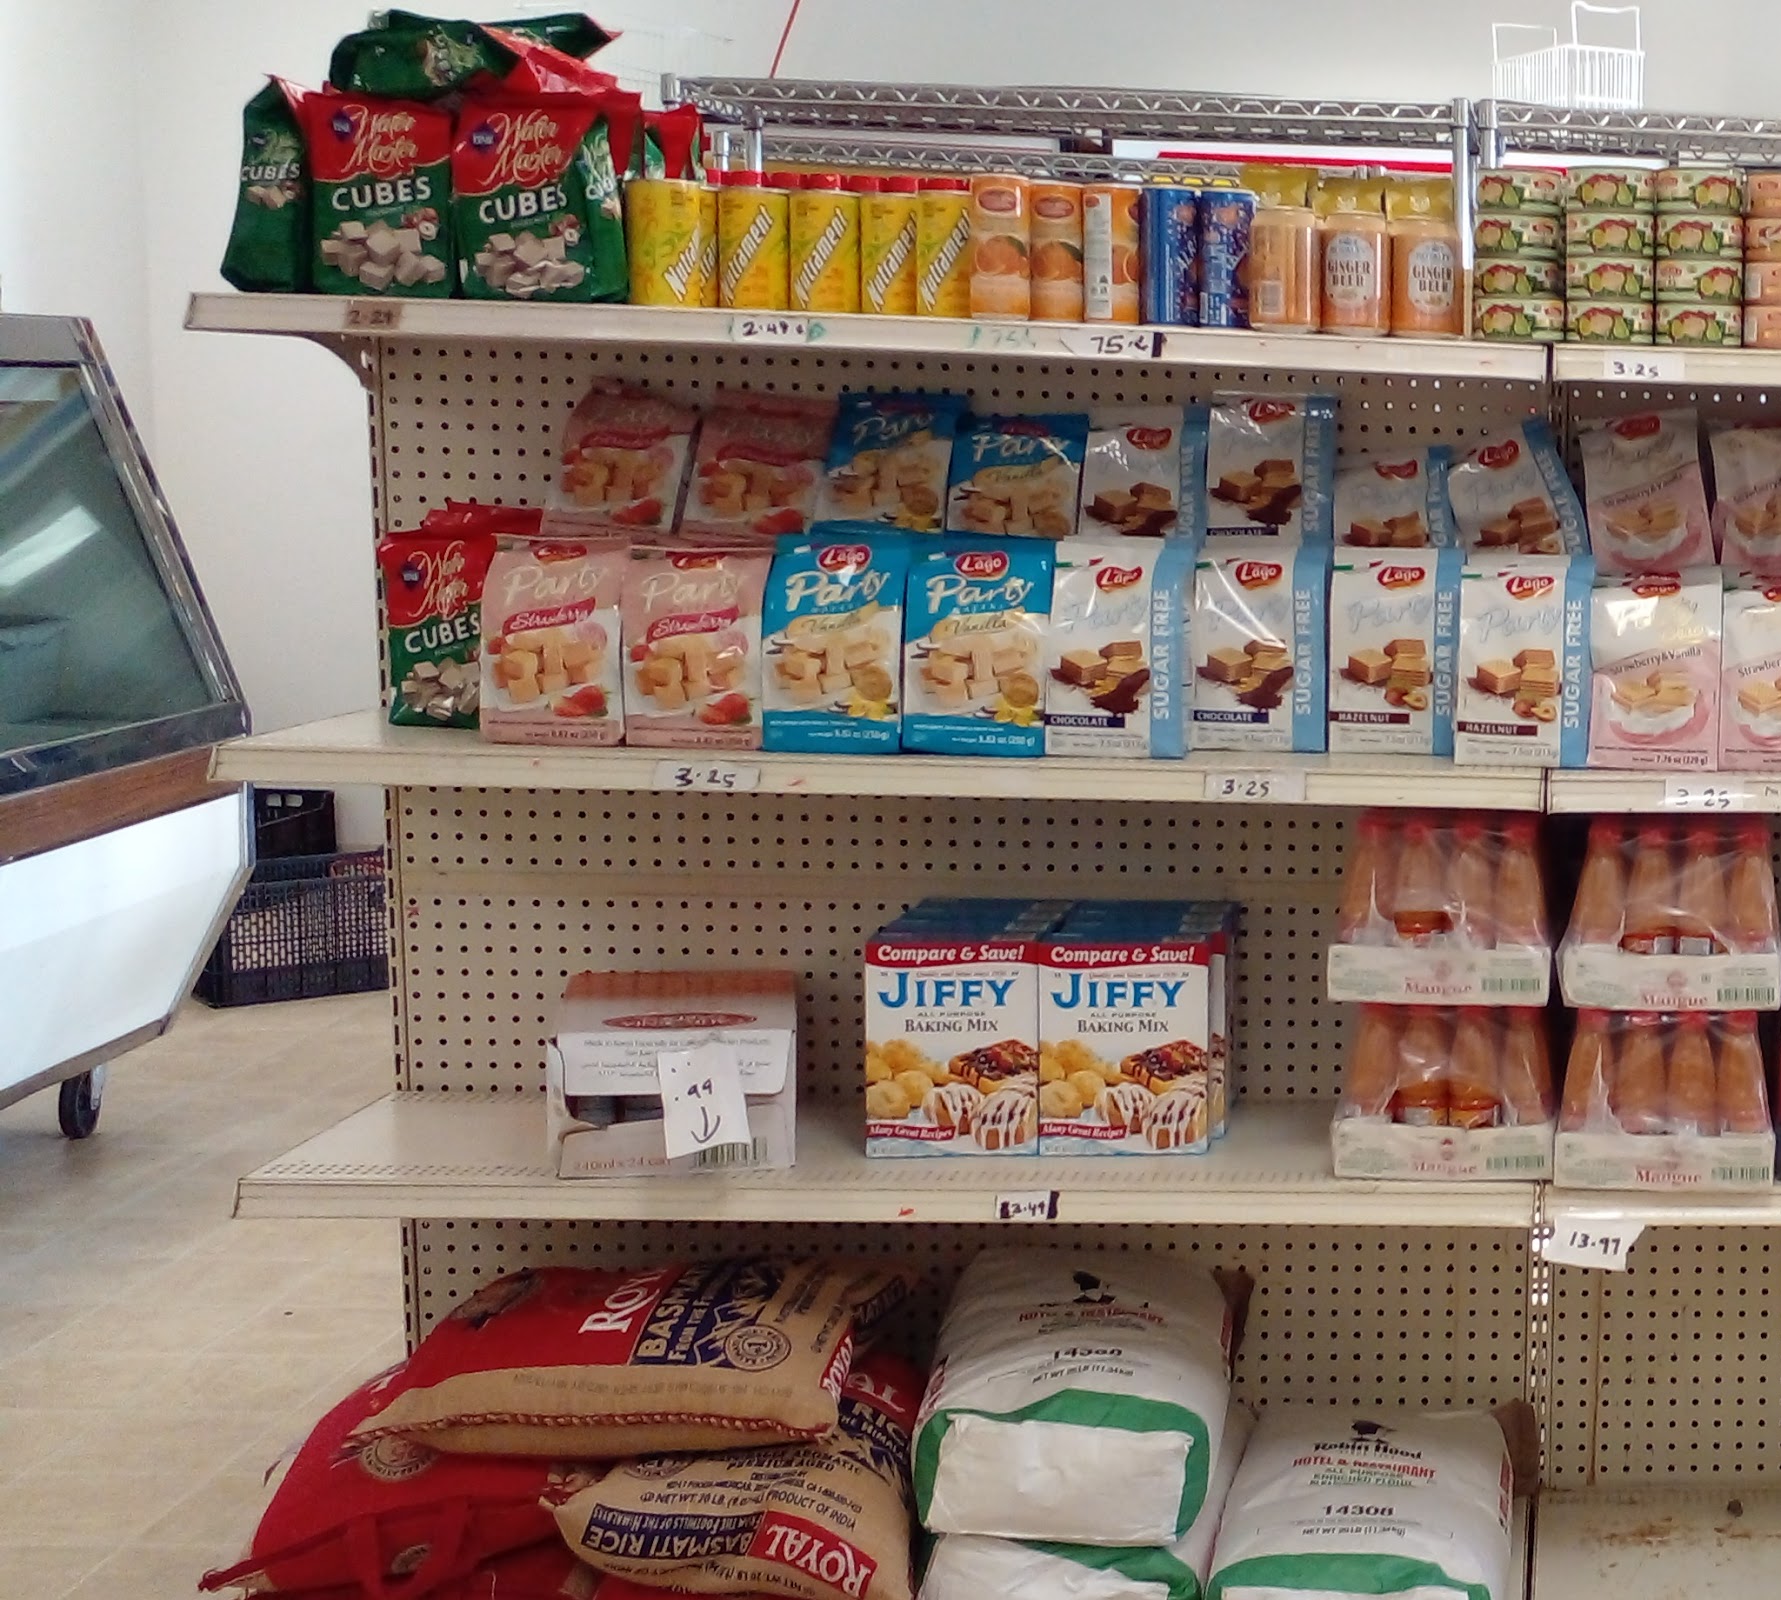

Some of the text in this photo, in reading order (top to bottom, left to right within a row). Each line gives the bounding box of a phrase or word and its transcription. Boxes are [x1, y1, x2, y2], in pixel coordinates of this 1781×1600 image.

[241, 163, 299, 181] CUBES
[332, 177, 431, 210] CUBES
[480, 184, 567, 223] CUBES
[720, 204, 774, 306] Nutrament
[793, 206, 849, 309] Nutrament
[1327, 259, 1372, 275] GINGER
[822, 548, 866, 571] Lago
[959, 555, 1003, 575] Lago
[502, 561, 602, 602] Party
[1240, 563, 1278, 581] Lago
[1382, 567, 1421, 586] Lago
[641, 570, 746, 611] Party
[785, 570, 891, 612] Party
[926, 575, 1034, 615] Party
[1510, 577, 1550, 596] Lago
[405, 612, 481, 655] CUBES
[1152, 589, 1170, 720] SUGAR FREE
[1294, 589, 1312, 715] SUGAR FREE
[1435, 591, 1453, 717] SUGAR FREE
[1563, 600, 1584, 728] SUGAR FREE
[1050, 715, 1109, 727] CHOCOLATE
[1196, 712, 1253, 723] CHOCOLATE
[1338, 713, 1390, 723] HAZELNUT
[1466, 723, 1519, 735] HAZELNUT
[675, 767, 736, 787] 3.25
[1222, 779, 1270, 797] 3.25
[878, 944, 1025, 963] Compare & Save!
[1050, 946, 1196, 964] Compare & Save!
[877, 971, 1017, 1009] JIFFY
[1050, 973, 1188, 1010] JIFFY
[1404, 980, 1472, 996] Mangue
[905, 1018, 998, 1033] BAKING MIX
[1077, 1019, 1170, 1034] BAKING MIX
[869, 1124, 893, 1138] Many
[919, 1127, 953, 1140] Recipes
[1042, 1124, 1125, 1139] Many Recipes
[1635, 1168, 1701, 1186] Mangue
[1314, 1439, 1422, 1460] Robin Hood
[1293, 1454, 1333, 1468] HOTEL
[767, 1489, 813, 1509] PRODUCT
[815, 1501, 830, 1515] OF
[829, 1507, 857, 1533] INDIA
[586, 1525, 872, 1598] ROYAL BASMATI RICE
